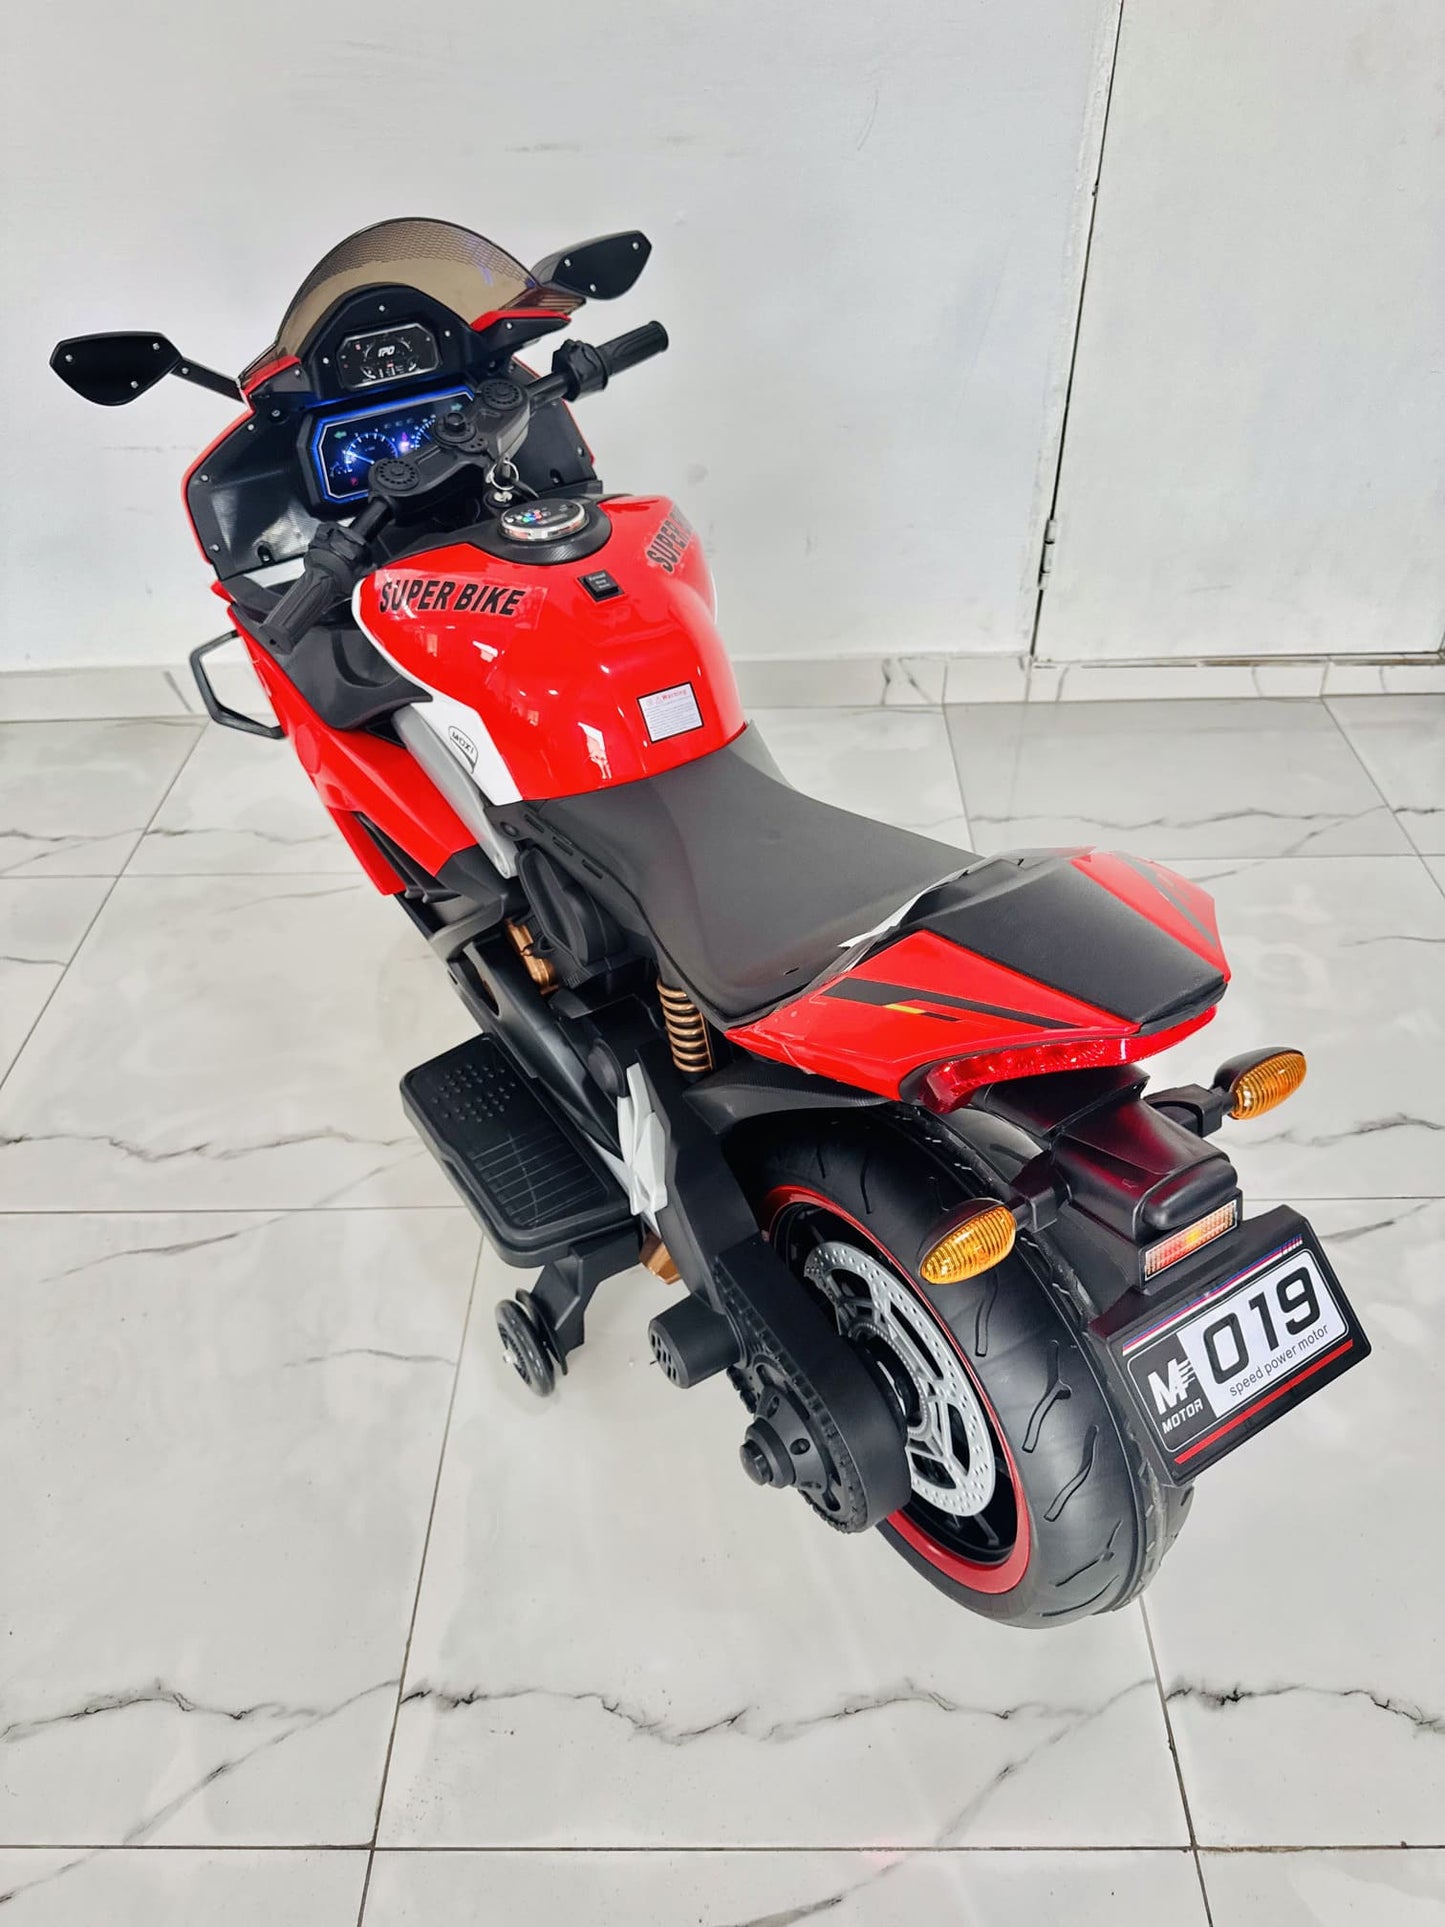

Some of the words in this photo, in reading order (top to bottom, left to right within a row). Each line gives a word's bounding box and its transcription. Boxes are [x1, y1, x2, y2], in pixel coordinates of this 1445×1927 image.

[646, 519, 689, 573] SUPER
[380, 580, 455, 612] SUPER
[453, 583, 526, 615] BIKE
[1203, 1266, 1321, 1384] 019
[1229, 1366, 1264, 1396] speed
[1264, 1345, 1297, 1376] power
[1298, 1325, 1329, 1351] motor
[1162, 1398, 1203, 1434] MOTOR
